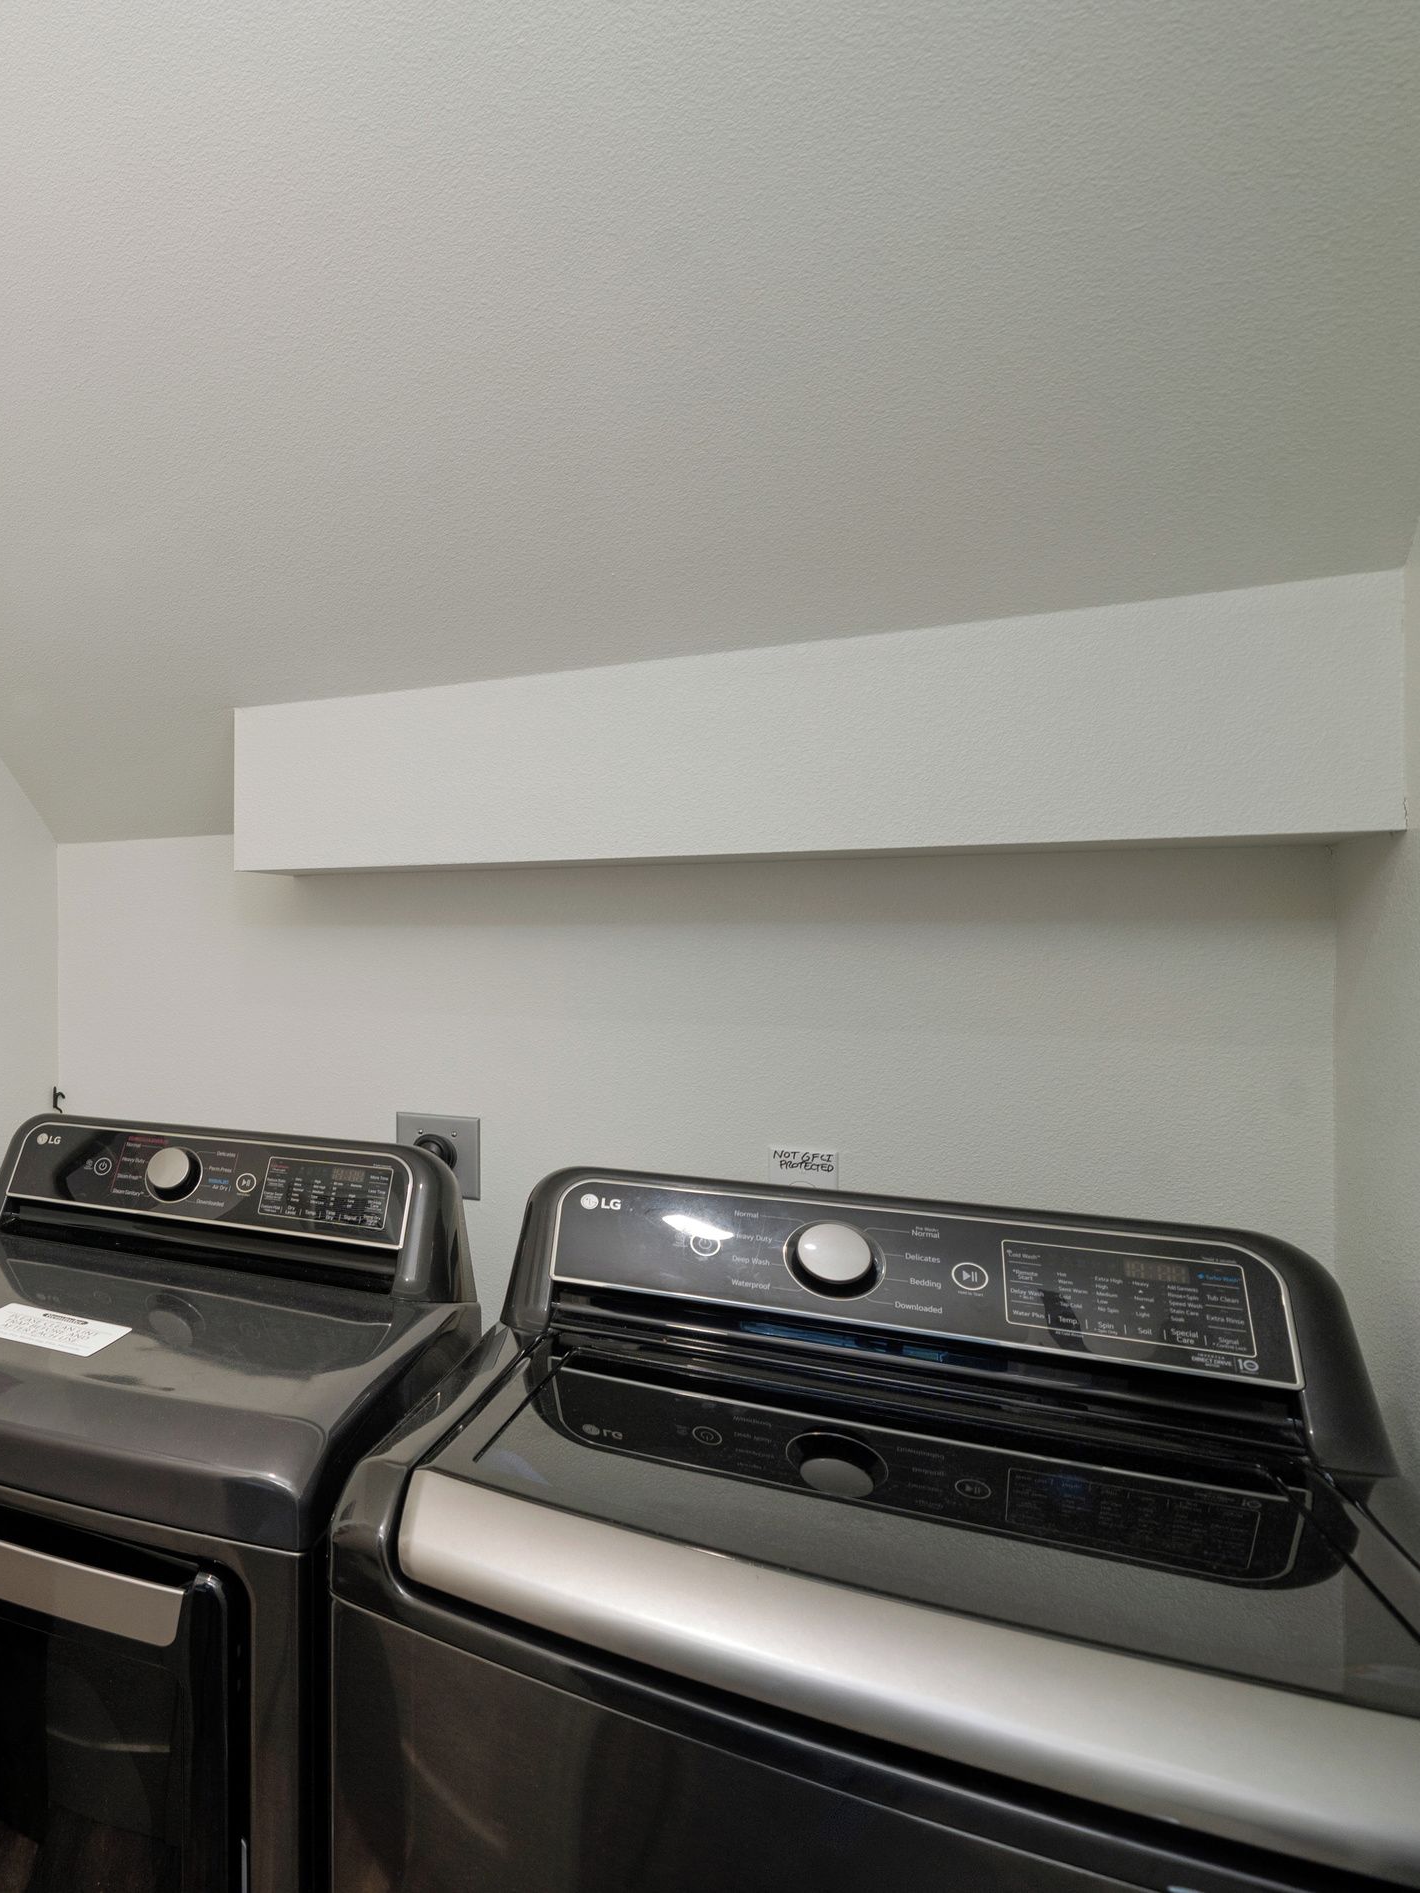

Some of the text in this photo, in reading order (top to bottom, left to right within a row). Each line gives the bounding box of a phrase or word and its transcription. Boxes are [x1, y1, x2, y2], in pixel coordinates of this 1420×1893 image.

[47, 1134, 62, 1145] LG
[216, 1150, 236, 1158] Delicates
[772, 1149, 834, 1163] NOT GFCI
[779, 1159, 835, 1173] PROTECTED
[196, 1198, 225, 1208] Downloaded
[600, 1197, 622, 1211] LG
[734, 1209, 759, 1220] Normal
[755, 1234, 773, 1244] Duty
[911, 1229, 940, 1239] Normal
[732, 1255, 770, 1267] Deep Wash
[904, 1252, 941, 1264] Delicates
[1017, 1273, 1033, 1281] Start
[1057, 1278, 1073, 1286] Warm
[1094, 1275, 1123, 1284] Extra High
[731, 1278, 771, 1291] Waterproof
[909, 1277, 942, 1290] Bedding
[1131, 1280, 1150, 1289] Heavy
[1010, 1287, 1044, 1298] Delay Wash
[1072, 1287, 1088, 1295] Warm
[1095, 1291, 1118, 1299] Medium
[1058, 1293, 1071, 1301] Cold
[1133, 1295, 1155, 1303] Normal
[1206, 1294, 1240, 1304] Tub Clean
[894, 1300, 943, 1315] Downloaded
[1070, 1302, 1083, 1310] Cold
[1168, 1299, 1204, 1310] Speed Wash
[1012, 1309, 1045, 1319] Water Plus
[1106, 1307, 1120, 1315] Spin
[1135, 1311, 1151, 1319] Light
[1169, 1307, 1200, 1317] Stain Care
[1206, 1314, 1245, 1326] Extra Rinse
[1097, 1320, 1115, 1331] Spin
[1137, 1327, 1152, 1336] Soil
[1170, 1327, 1199, 1339] Special
[1176, 1335, 1195, 1345] Care
[1217, 1336, 1240, 1347] Signal
[1213, 1357, 1233, 1367] DRIVE
